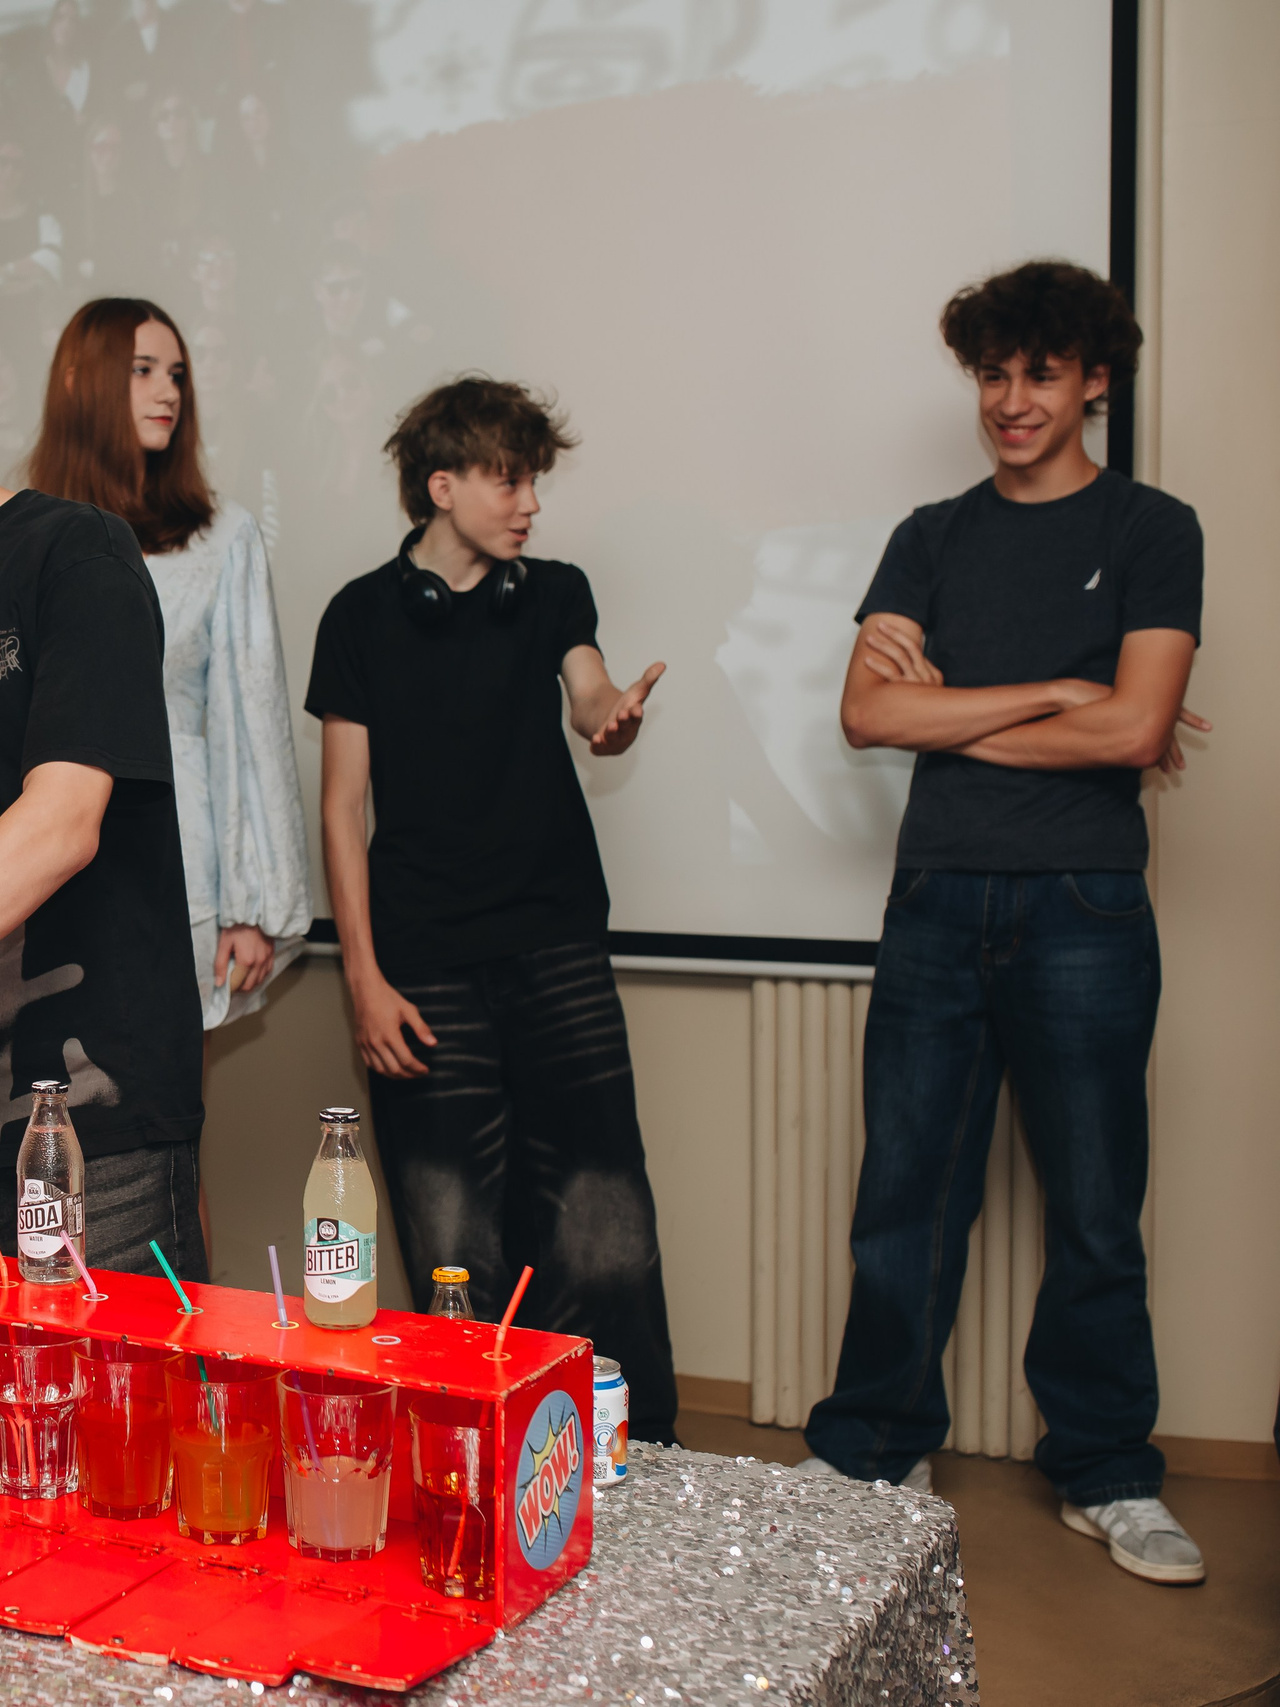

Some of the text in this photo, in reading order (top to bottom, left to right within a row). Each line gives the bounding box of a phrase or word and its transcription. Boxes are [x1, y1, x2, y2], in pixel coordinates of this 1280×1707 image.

[19, 1204, 59, 1231] SODA
[307, 1245, 355, 1272] BITTER
[320, 1277, 337, 1286] LEMON
[518, 1413, 579, 1548] WOW!
